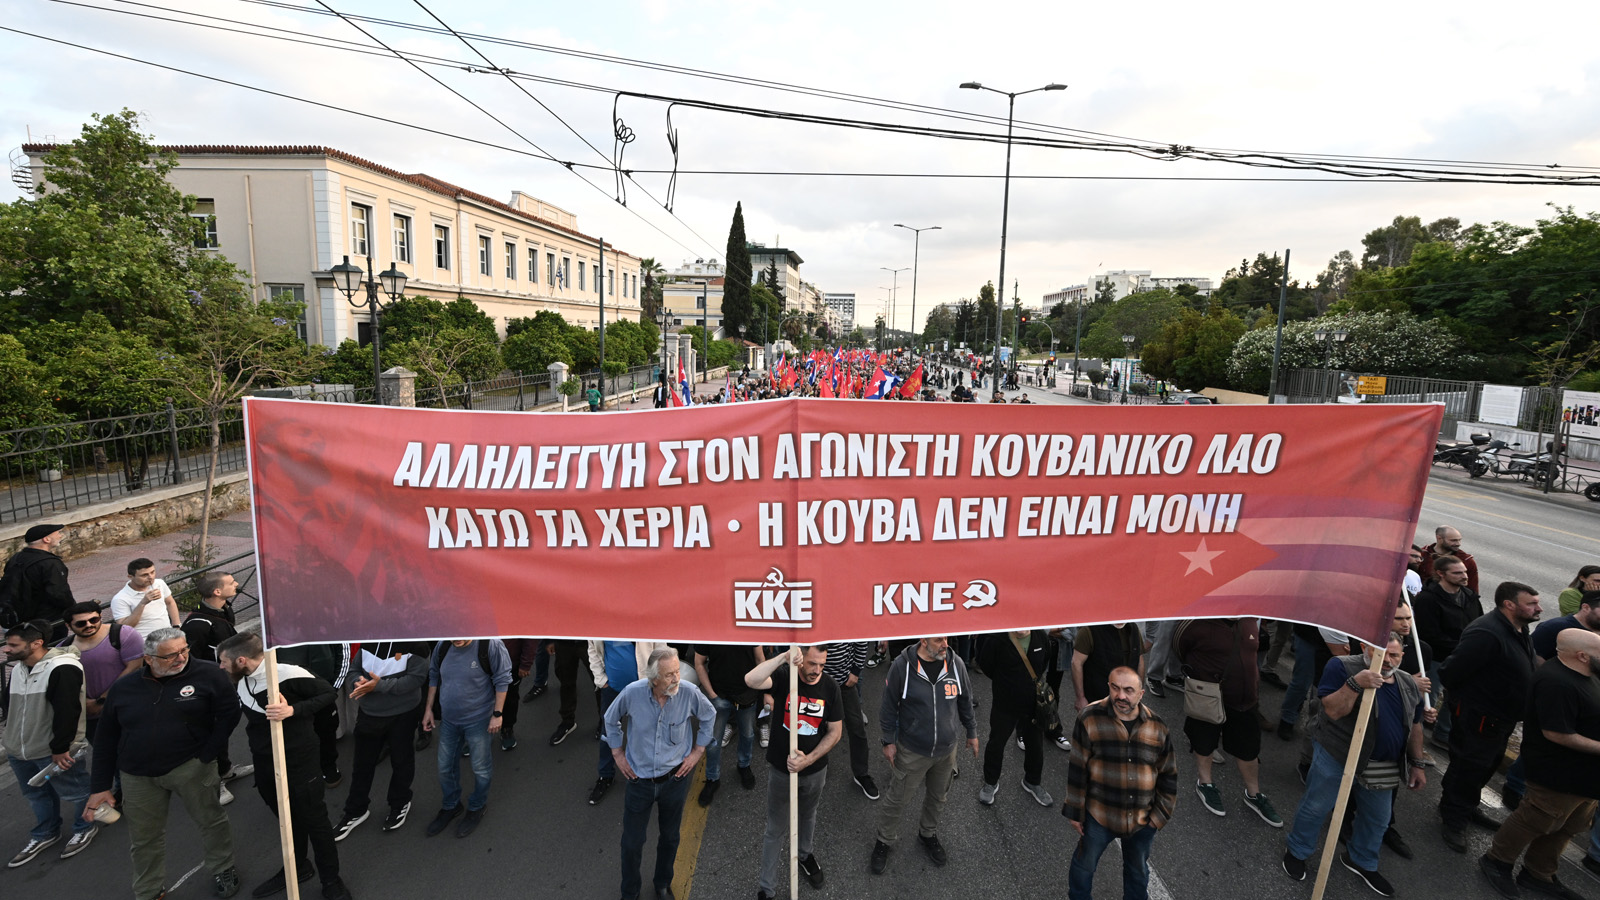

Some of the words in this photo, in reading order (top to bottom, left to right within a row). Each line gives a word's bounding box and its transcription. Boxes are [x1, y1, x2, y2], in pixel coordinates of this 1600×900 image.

[393, 442, 646, 489] ΑΛΛΗΛΕΓΓΥΗ
[658, 436, 760, 486] ΣΤΟΝ
[773, 433, 960, 478] ΑΓΩΝΙΣΤΗ
[971, 434, 1193, 476] ΚΟΥΒΑΝΙΚΟ
[1197, 433, 1282, 474] ΛΑΟ
[425, 507, 529, 548] ΚΑΤΩ
[535, 509, 588, 547] ΤΑ
[595, 505, 711, 547] ΧΕΡΙΑ
[759, 503, 783, 546] Η
[798, 498, 920, 545] ΚΟΥΒΑ
[932, 497, 1008, 540] ΔΕΝ
[1018, 496, 1119, 537] ΕΙΝΑΙ
[1126, 494, 1243, 533] ΜΟΝΗ
[735, 590, 813, 620] ΚΚΕ
[874, 583, 956, 615] ΚΝΕ
[944, 684, 957, 696] 90
